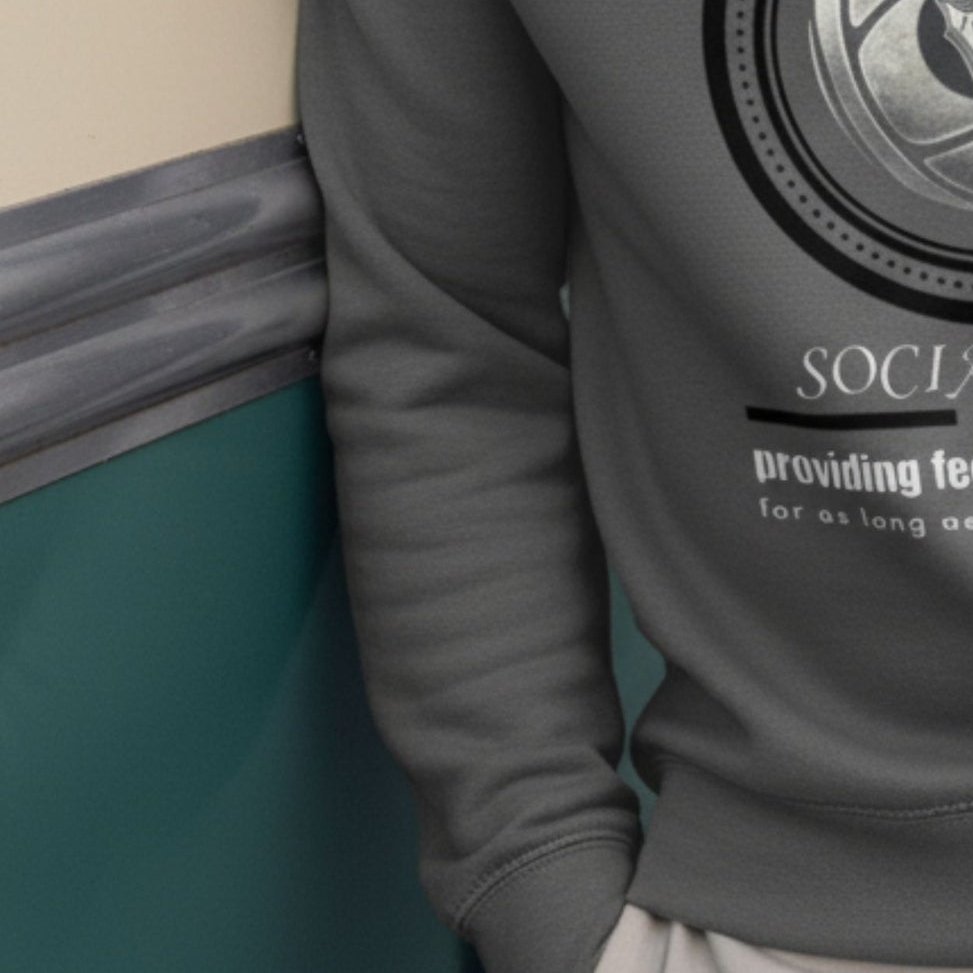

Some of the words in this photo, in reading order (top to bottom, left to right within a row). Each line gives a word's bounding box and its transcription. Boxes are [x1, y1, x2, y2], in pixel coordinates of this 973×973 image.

[753, 448, 922, 498] providing
[759, 497, 802, 519] for
[860, 507, 926, 538] long
